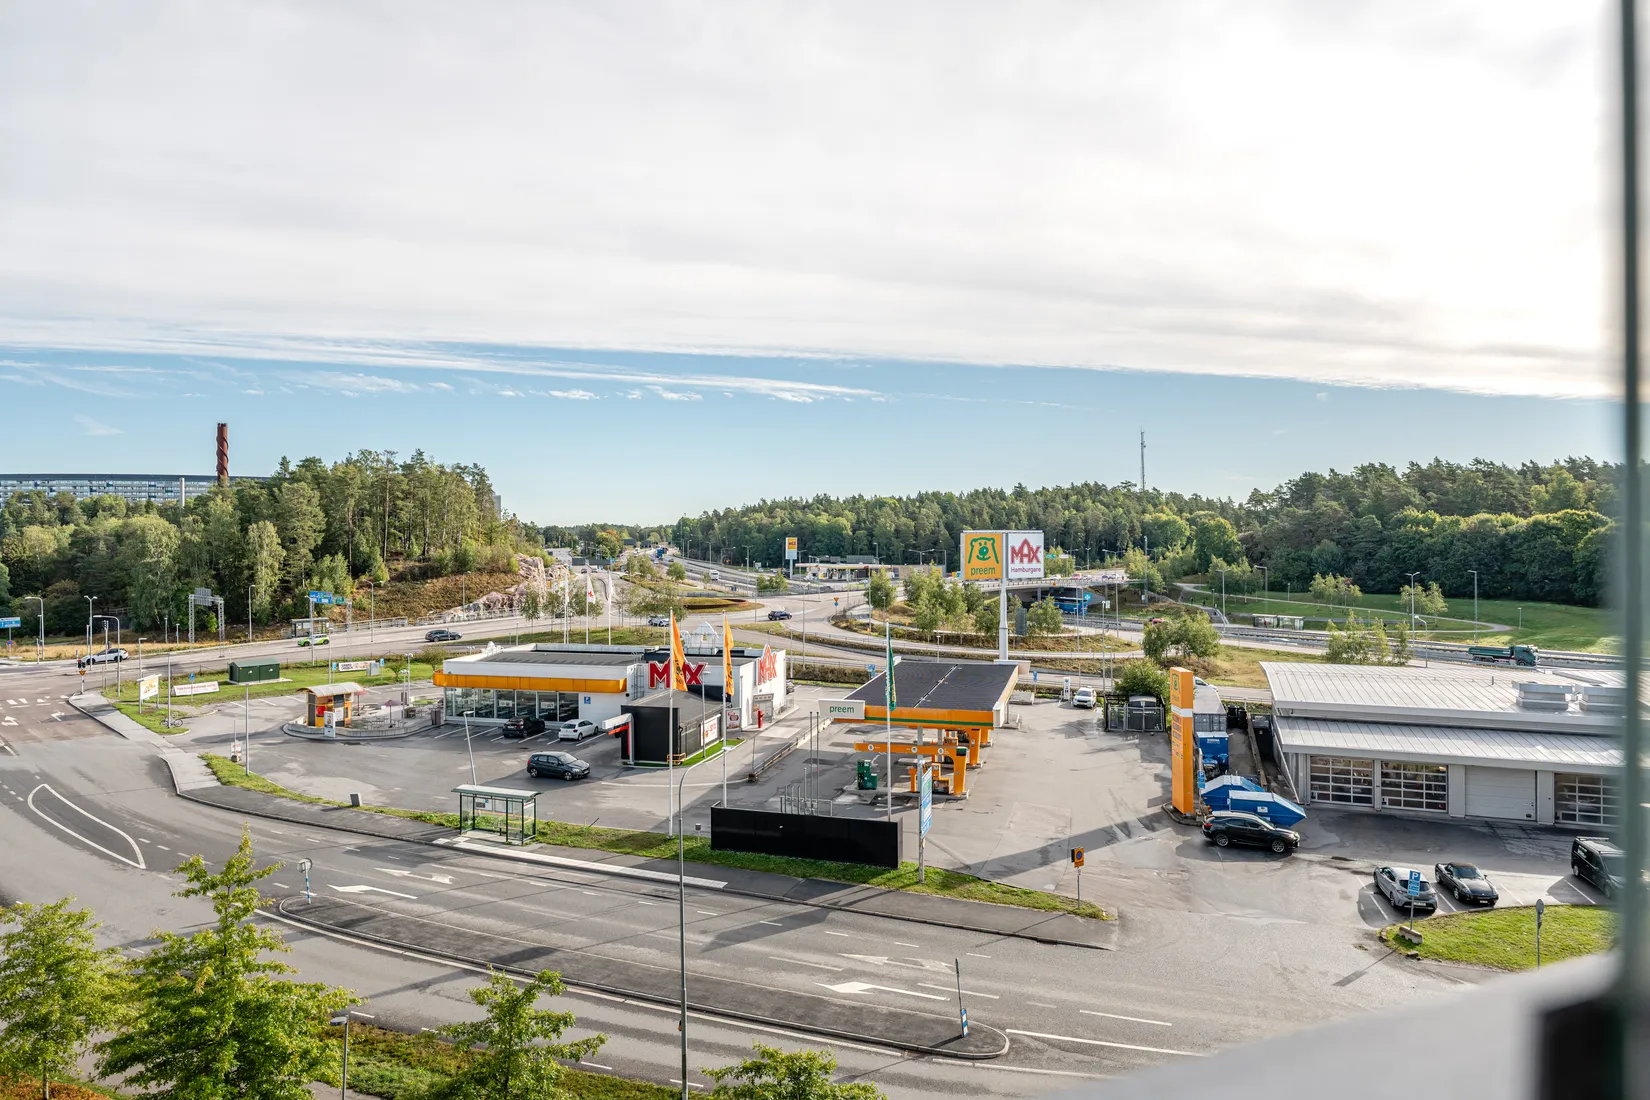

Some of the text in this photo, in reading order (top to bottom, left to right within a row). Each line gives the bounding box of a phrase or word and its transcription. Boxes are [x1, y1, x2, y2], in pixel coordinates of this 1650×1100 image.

[1010, 538, 1041, 564] MAX
[971, 567, 995, 576] preem
[648, 656, 708, 690] MX
[757, 643, 777, 686] MAX
[829, 704, 855, 714] preem
[1412, 872, 1418, 880] P
